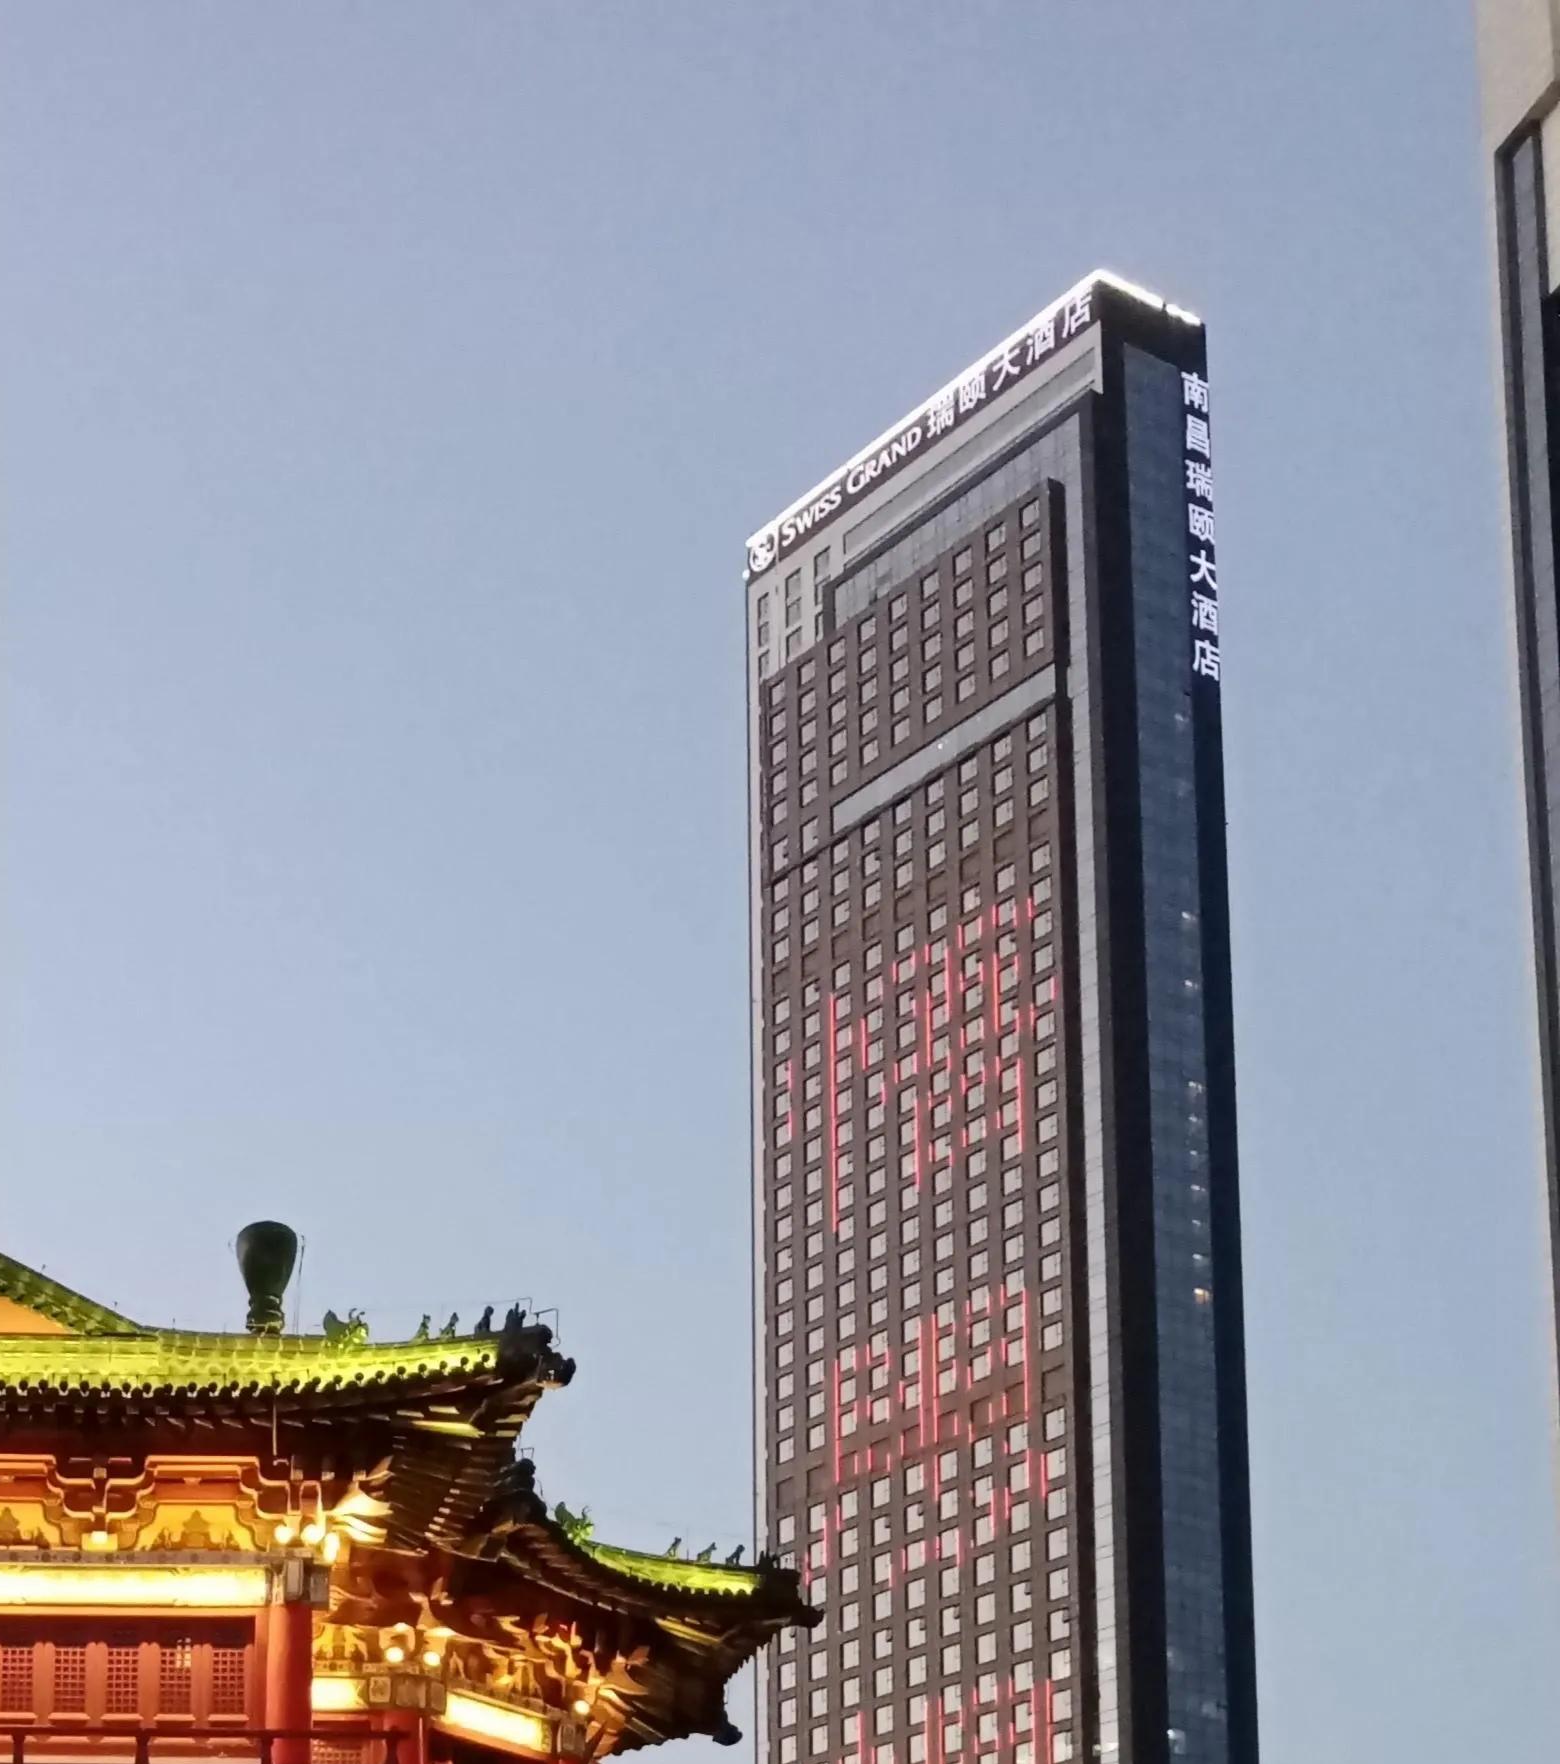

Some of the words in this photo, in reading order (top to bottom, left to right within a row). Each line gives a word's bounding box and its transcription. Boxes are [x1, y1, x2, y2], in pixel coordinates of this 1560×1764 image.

[781, 485, 842, 547] SWISS
[846, 426, 922, 494] GRAND
[926, 292, 1093, 439] 瑞颐大酒店
[1181, 371, 1220, 682] 南昌瑞颐大酒店
